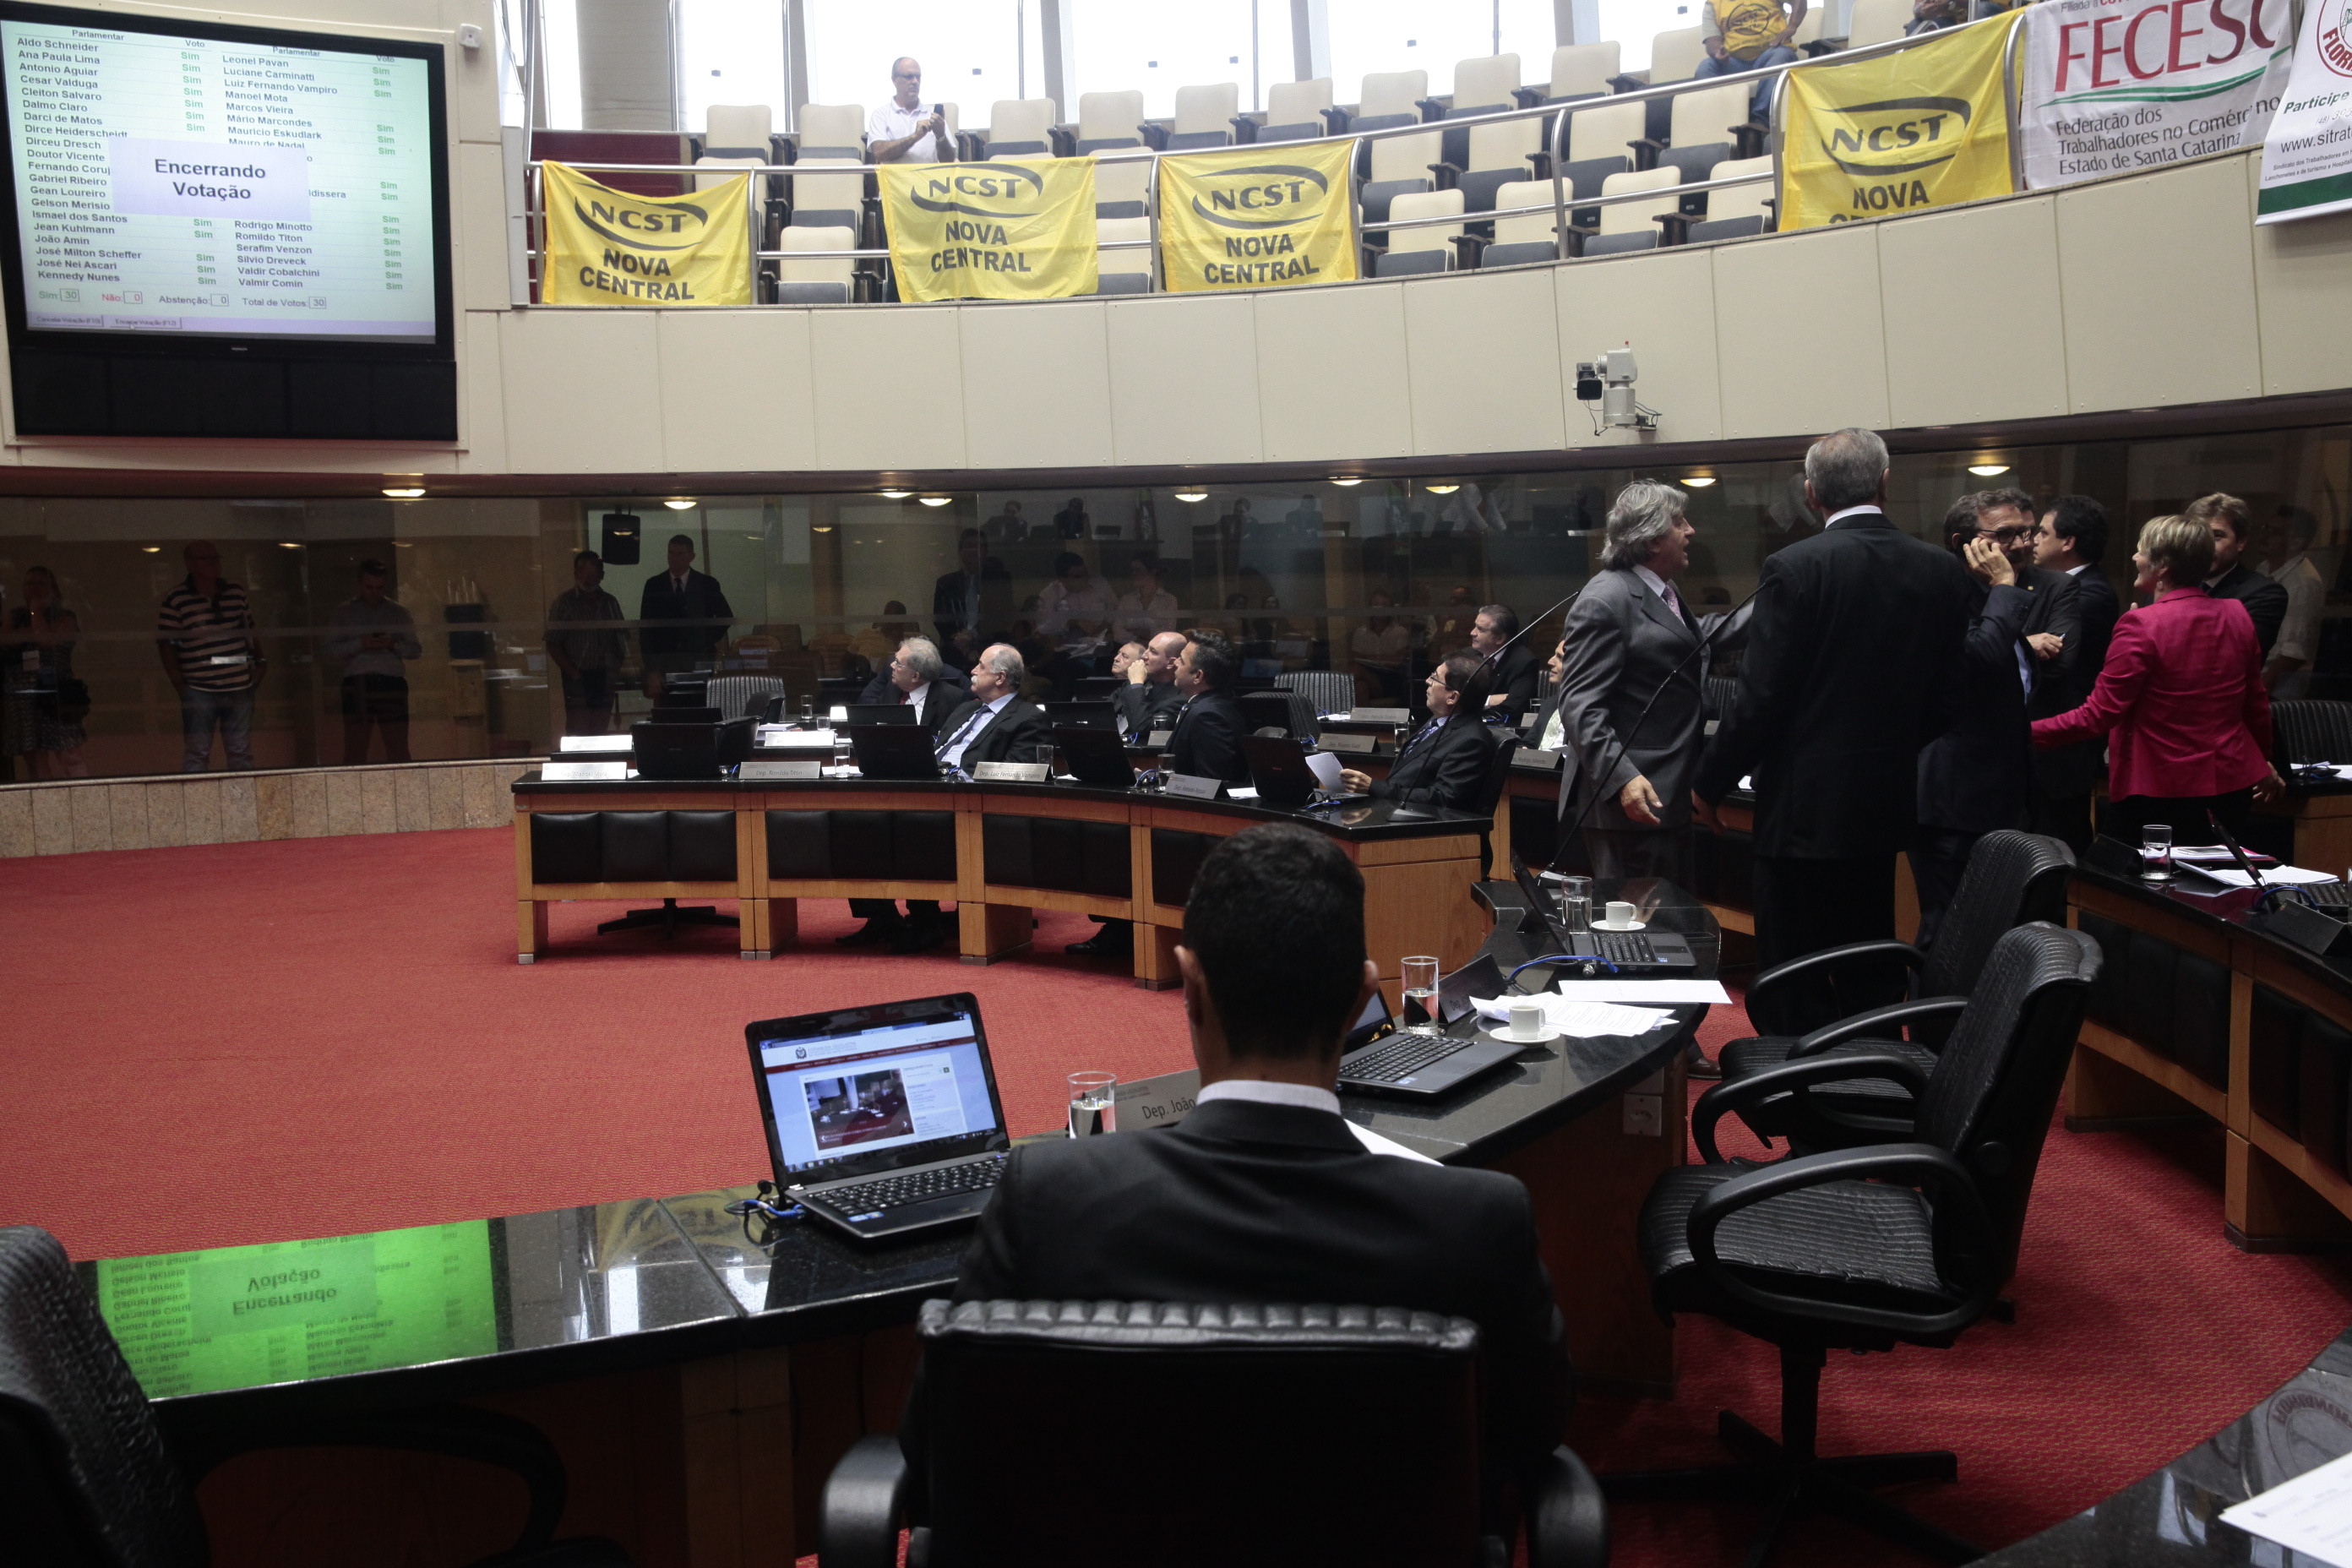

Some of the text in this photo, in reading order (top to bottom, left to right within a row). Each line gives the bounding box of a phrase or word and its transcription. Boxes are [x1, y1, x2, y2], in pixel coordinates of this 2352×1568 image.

[72, 29, 124, 41] Parlamentar
[17, 37, 98, 52] Aldo Schneider
[184, 39, 205, 47] Voto
[18, 49, 100, 64] Ana Paula Lima
[181, 52, 200, 61] Sim
[272, 46, 320, 57] Parlamentar
[222, 54, 289, 68] Leonel Pavan
[19, 62, 97, 76] Antonio Aguiar
[182, 63, 201, 73] Sim
[223, 66, 315, 81] Luciane Carminatti
[372, 67, 390, 75] Sim
[20, 74, 98, 90] Cesar Valduga
[182, 76, 202, 85] Sim
[373, 79, 391, 87] Sim
[224, 79, 338, 95] Luiz Fernando Vampiro
[21, 87, 101, 101] Cleiton Salvaro
[225, 90, 288, 102] Manoel Mota
[374, 90, 392, 99] Sim
[22, 99, 88, 112] Dalmo Claro
[184, 100, 204, 109] Sim
[226, 102, 293, 115] Marcos Vieira
[2284, 91, 2350, 115] Participe
[24, 112, 102, 125] Darci de Matos
[185, 112, 204, 121] Sim
[226, 114, 313, 128] Mário Marcondes
[2055, 108, 2163, 136] Federação dos
[24, 124, 52, 133] Dirce
[186, 123, 205, 133] Sim
[273, 128, 322, 139] Eskudlark
[377, 124, 395, 133] Sim
[1832, 113, 1948, 153] NCST
[25, 136, 101, 150] Dirceu Dresch
[378, 136, 395, 144] Sim
[2058, 130, 2159, 155] Trabalhadores
[2163, 126, 2183, 142] no
[2281, 125, 2352, 154] www.sitrat
[26, 149, 105, 161] Doutor Vicente
[378, 147, 396, 155] Sim
[2060, 156, 2108, 176] Estado
[2111, 153, 2131, 169] de
[2134, 147, 2178, 166] Santa
[2306, 153, 2341, 165] Trabalhadores
[28, 161, 79, 172] Fernando
[155, 159, 266, 178] Encerrando
[29, 173, 106, 186] Gabriel Ribeiro
[30, 185, 106, 198] Gean Loureiro
[172, 182, 252, 201] Votação
[379, 182, 398, 190] Sim
[928, 176, 1022, 199] NCST
[381, 193, 399, 201] Sim
[1211, 180, 1306, 211] NCST
[1853, 180, 1930, 211] NOVA
[31, 198, 110, 210] Gelson Merisio
[32, 210, 128, 223] Ismael dos Santos
[382, 215, 400, 224] Sim
[591, 200, 687, 233] NCST
[33, 222, 115, 234] Jean Kuhlmann
[193, 219, 213, 227] Sim
[234, 220, 313, 231] Rodrigo Minotto
[193, 230, 214, 239] Sim
[235, 231, 302, 242] Romildo Titon
[945, 220, 1009, 246] NOVA
[34, 234, 90, 245] João Amin
[1226, 233, 1295, 258] NOVA
[35, 246, 142, 259] José Milton Scheffer
[236, 243, 312, 254] Serafim Venzon
[384, 249, 401, 258] Sim
[36, 258, 117, 270] José Nei Ascari
[266, 255, 307, 265] Dreveck
[384, 260, 402, 269] Sim
[603, 248, 672, 277] NOVA
[931, 247, 1032, 273] CENTRAL
[197, 265, 216, 274] Sim
[237, 266, 319, 277] Valdir Cobalchini
[385, 271, 403, 280] Sim
[1204, 254, 1320, 285] CENTRAL
[37, 270, 120, 282] Kennedy Nunes
[198, 277, 217, 286] Sim
[238, 278, 303, 287] Valmir Comin
[580, 266, 695, 301] CENTRAL
[66, 291, 77, 299] 30
[242, 297, 264, 306] Total
[266, 298, 278, 307] de
[1141, 1097, 1196, 1120] Dep. João
